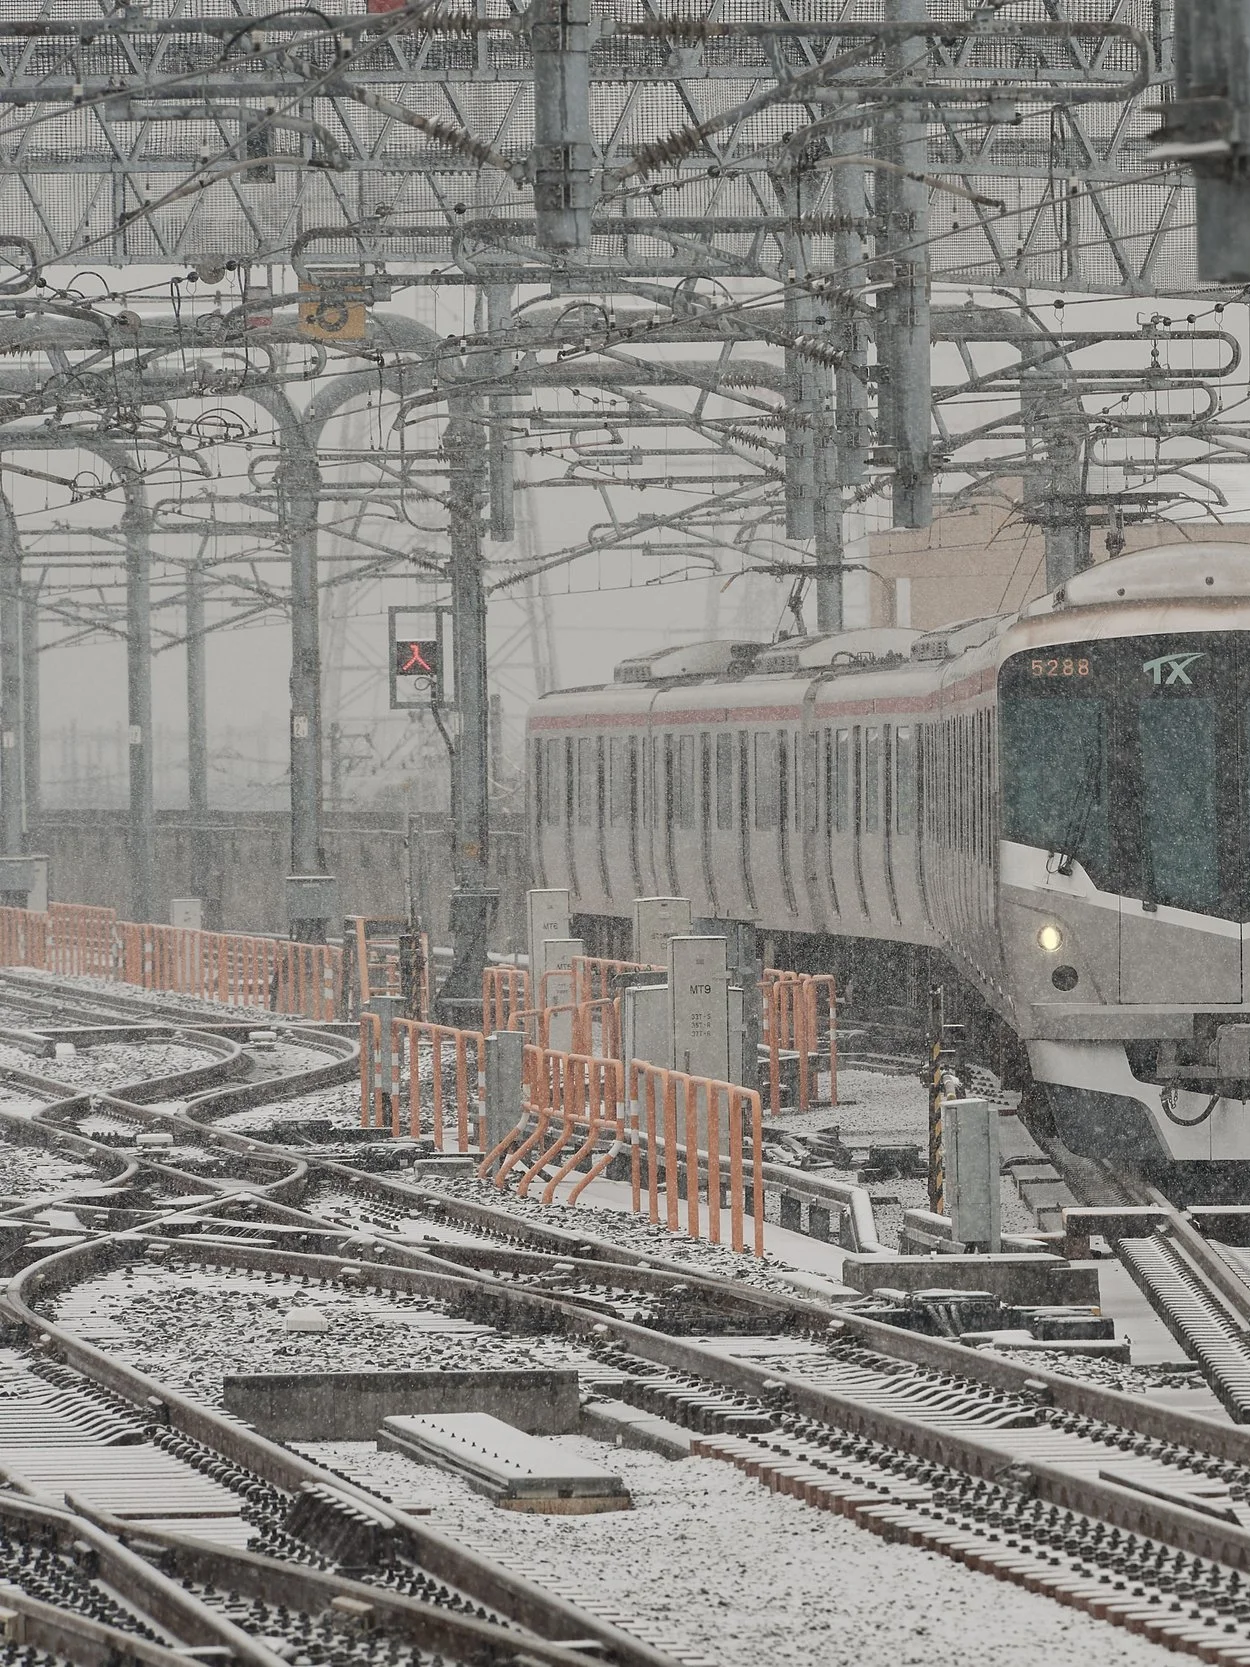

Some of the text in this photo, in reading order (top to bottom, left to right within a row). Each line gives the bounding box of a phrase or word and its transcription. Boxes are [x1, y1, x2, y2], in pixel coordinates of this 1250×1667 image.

[1031, 658, 1090, 676] 5288
[1143, 652, 1206, 685] TX
[690, 984, 711, 994] MT9
